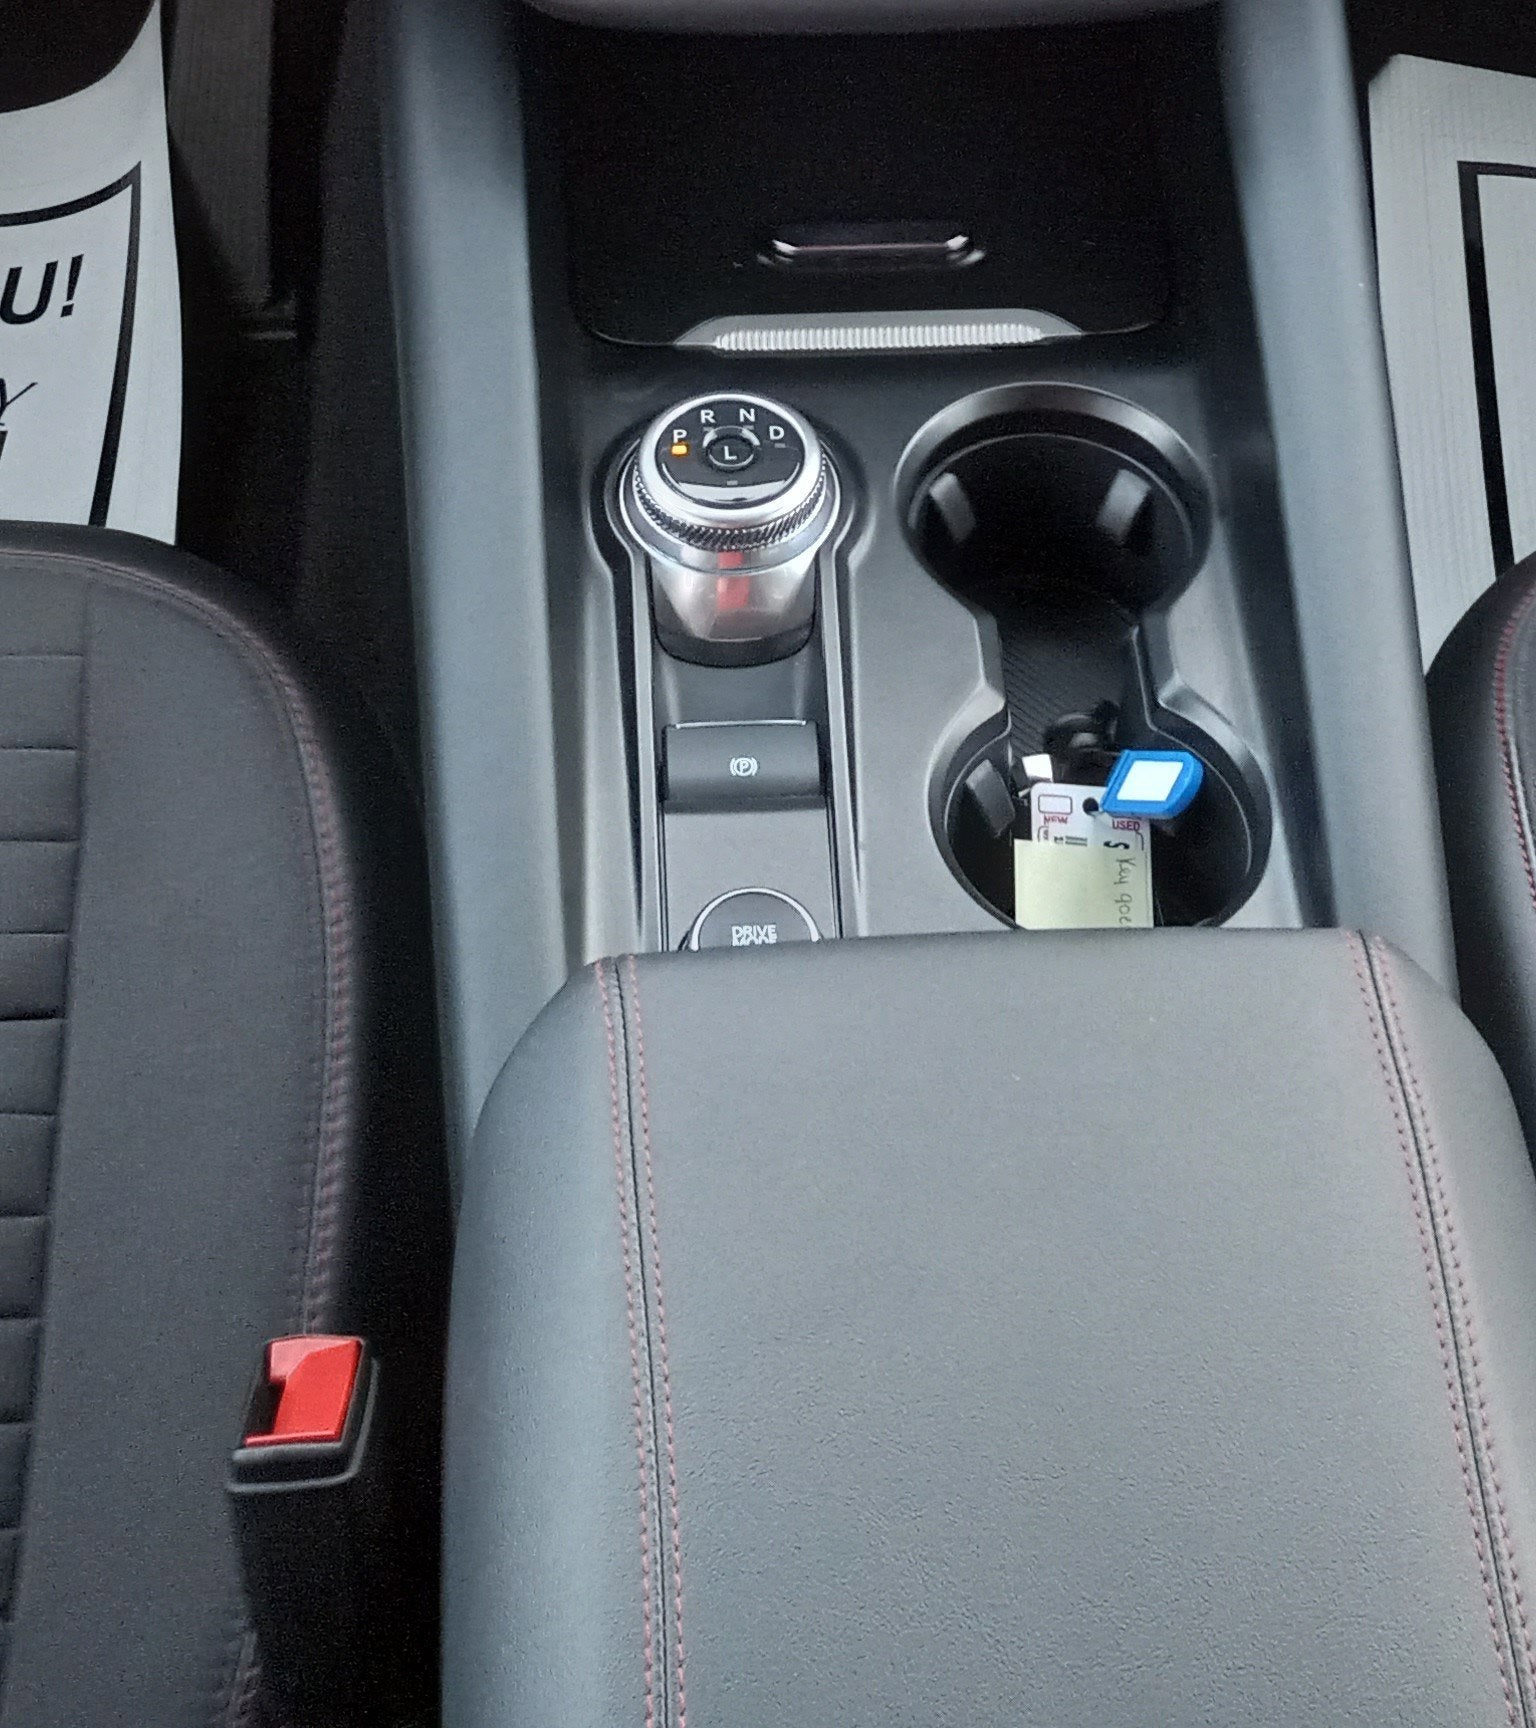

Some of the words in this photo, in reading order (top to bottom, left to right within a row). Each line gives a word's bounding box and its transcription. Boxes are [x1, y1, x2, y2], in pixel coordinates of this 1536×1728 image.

[672, 429, 688, 444] P
[700, 408, 716, 424] R
[739, 408, 756, 423] N
[768, 425, 785, 441] D
[724, 445, 738, 461] L
[1112, 819, 1141, 832] USED
